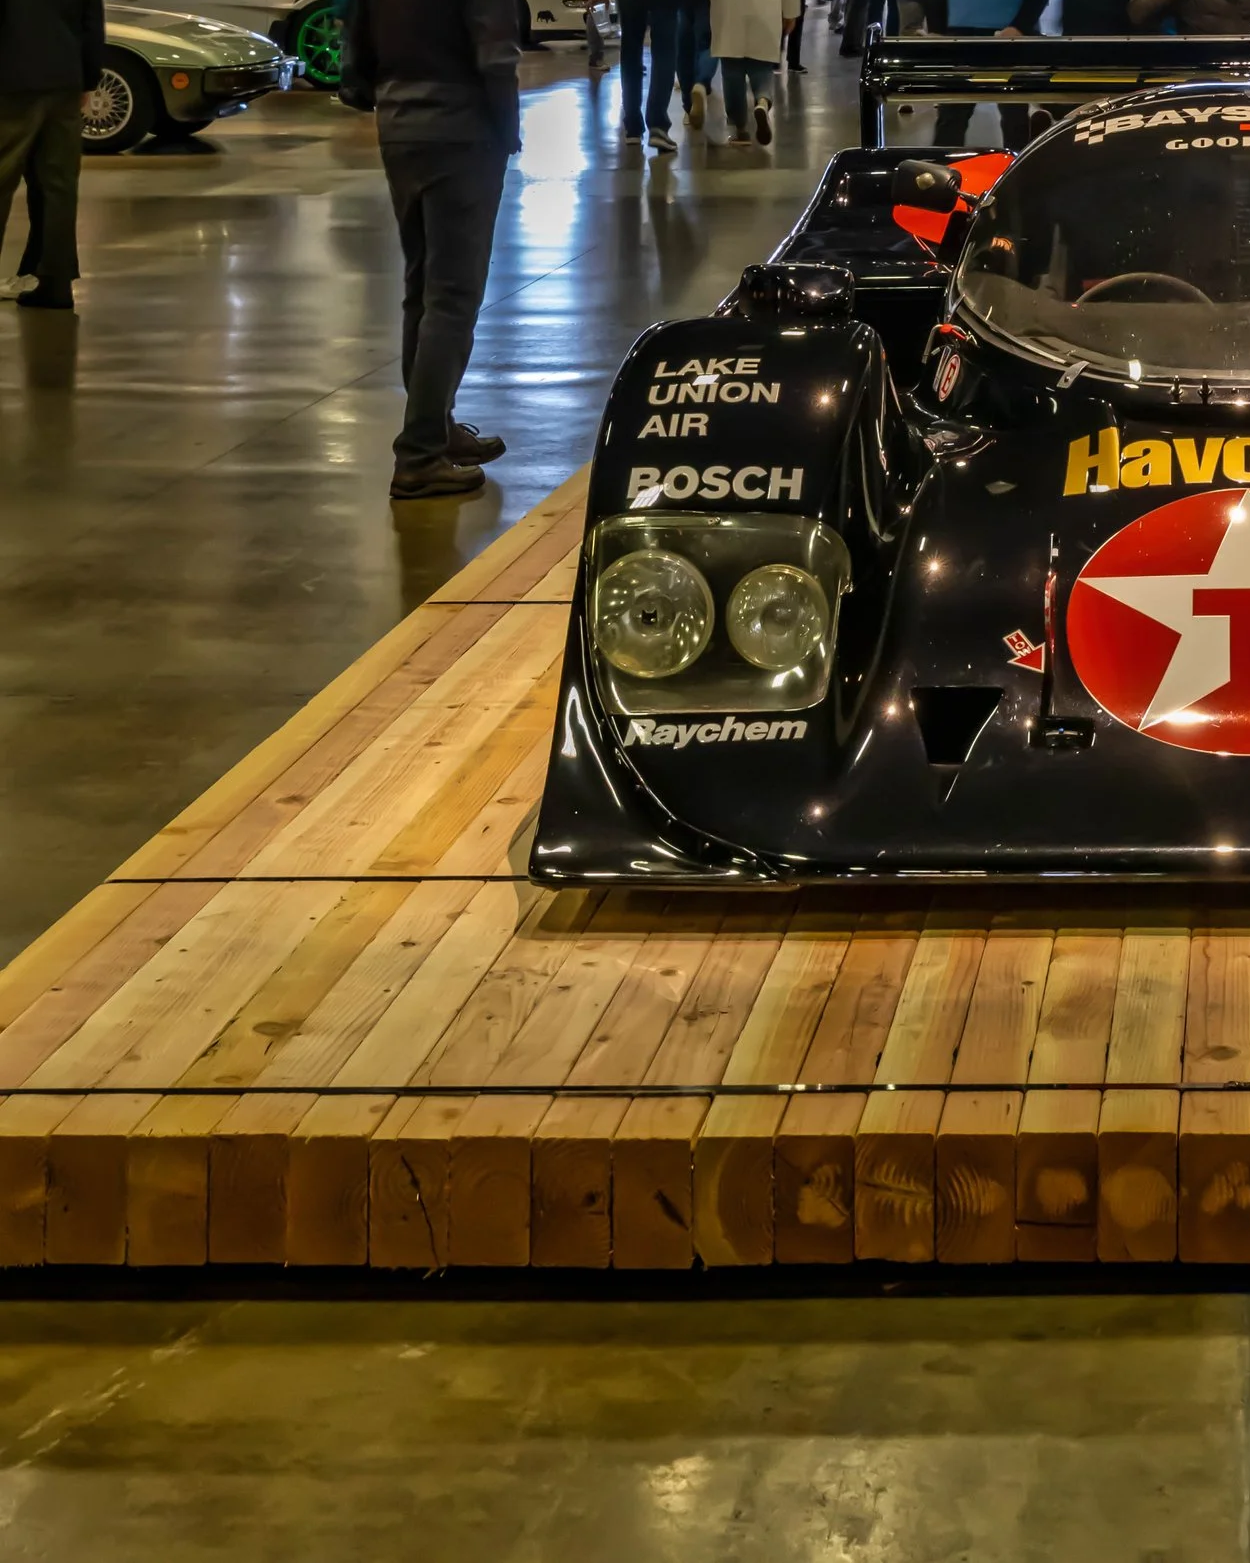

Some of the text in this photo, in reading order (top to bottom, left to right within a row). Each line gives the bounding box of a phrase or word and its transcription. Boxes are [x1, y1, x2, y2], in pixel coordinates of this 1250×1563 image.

[654, 358, 761, 378] LAKE
[648, 381, 780, 405] UNION
[637, 413, 709, 439] AIR
[626, 466, 804, 501] BOSCH
[1008, 634, 1031, 657] TOW
[623, 716, 808, 750] Raychem
